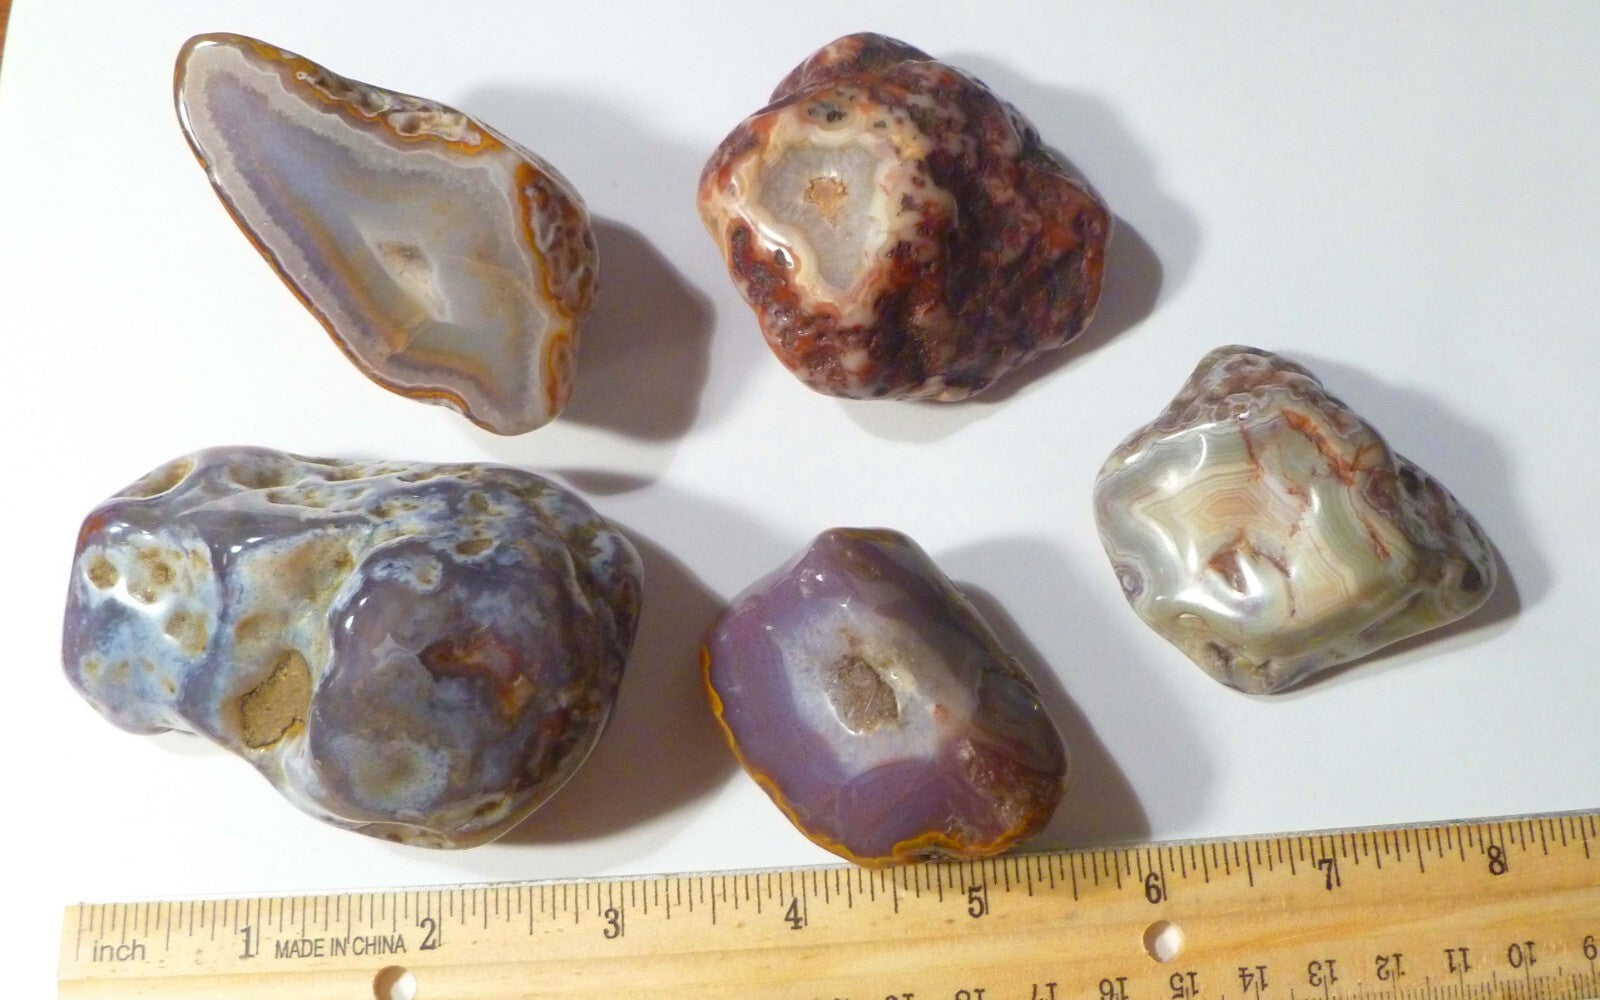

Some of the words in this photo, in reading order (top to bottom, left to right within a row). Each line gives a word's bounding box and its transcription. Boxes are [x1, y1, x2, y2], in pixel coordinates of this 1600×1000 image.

[1317, 858, 1335, 891] 7
[1487, 845, 1504, 876] 8
[968, 886, 985, 918] 5
[1144, 872, 1163, 904] 6
[603, 908, 621, 940] 3
[784, 897, 804, 930] 4
[238, 925, 255, 960] 1
[274, 938, 325, 959] MADE
[330, 937, 347, 957] IN
[352, 934, 407, 956] CHINA
[419, 917, 437, 950] 2
[92, 938, 146, 962] inch
[1444, 947, 1471, 974] 11
[1508, 941, 1537, 968] 10
[1238, 965, 1269, 993] 14
[1307, 959, 1339, 987] 13
[1375, 953, 1406, 981] 12
[1099, 976, 1129, 1000] 16
[1169, 971, 1200, 1000] 15
